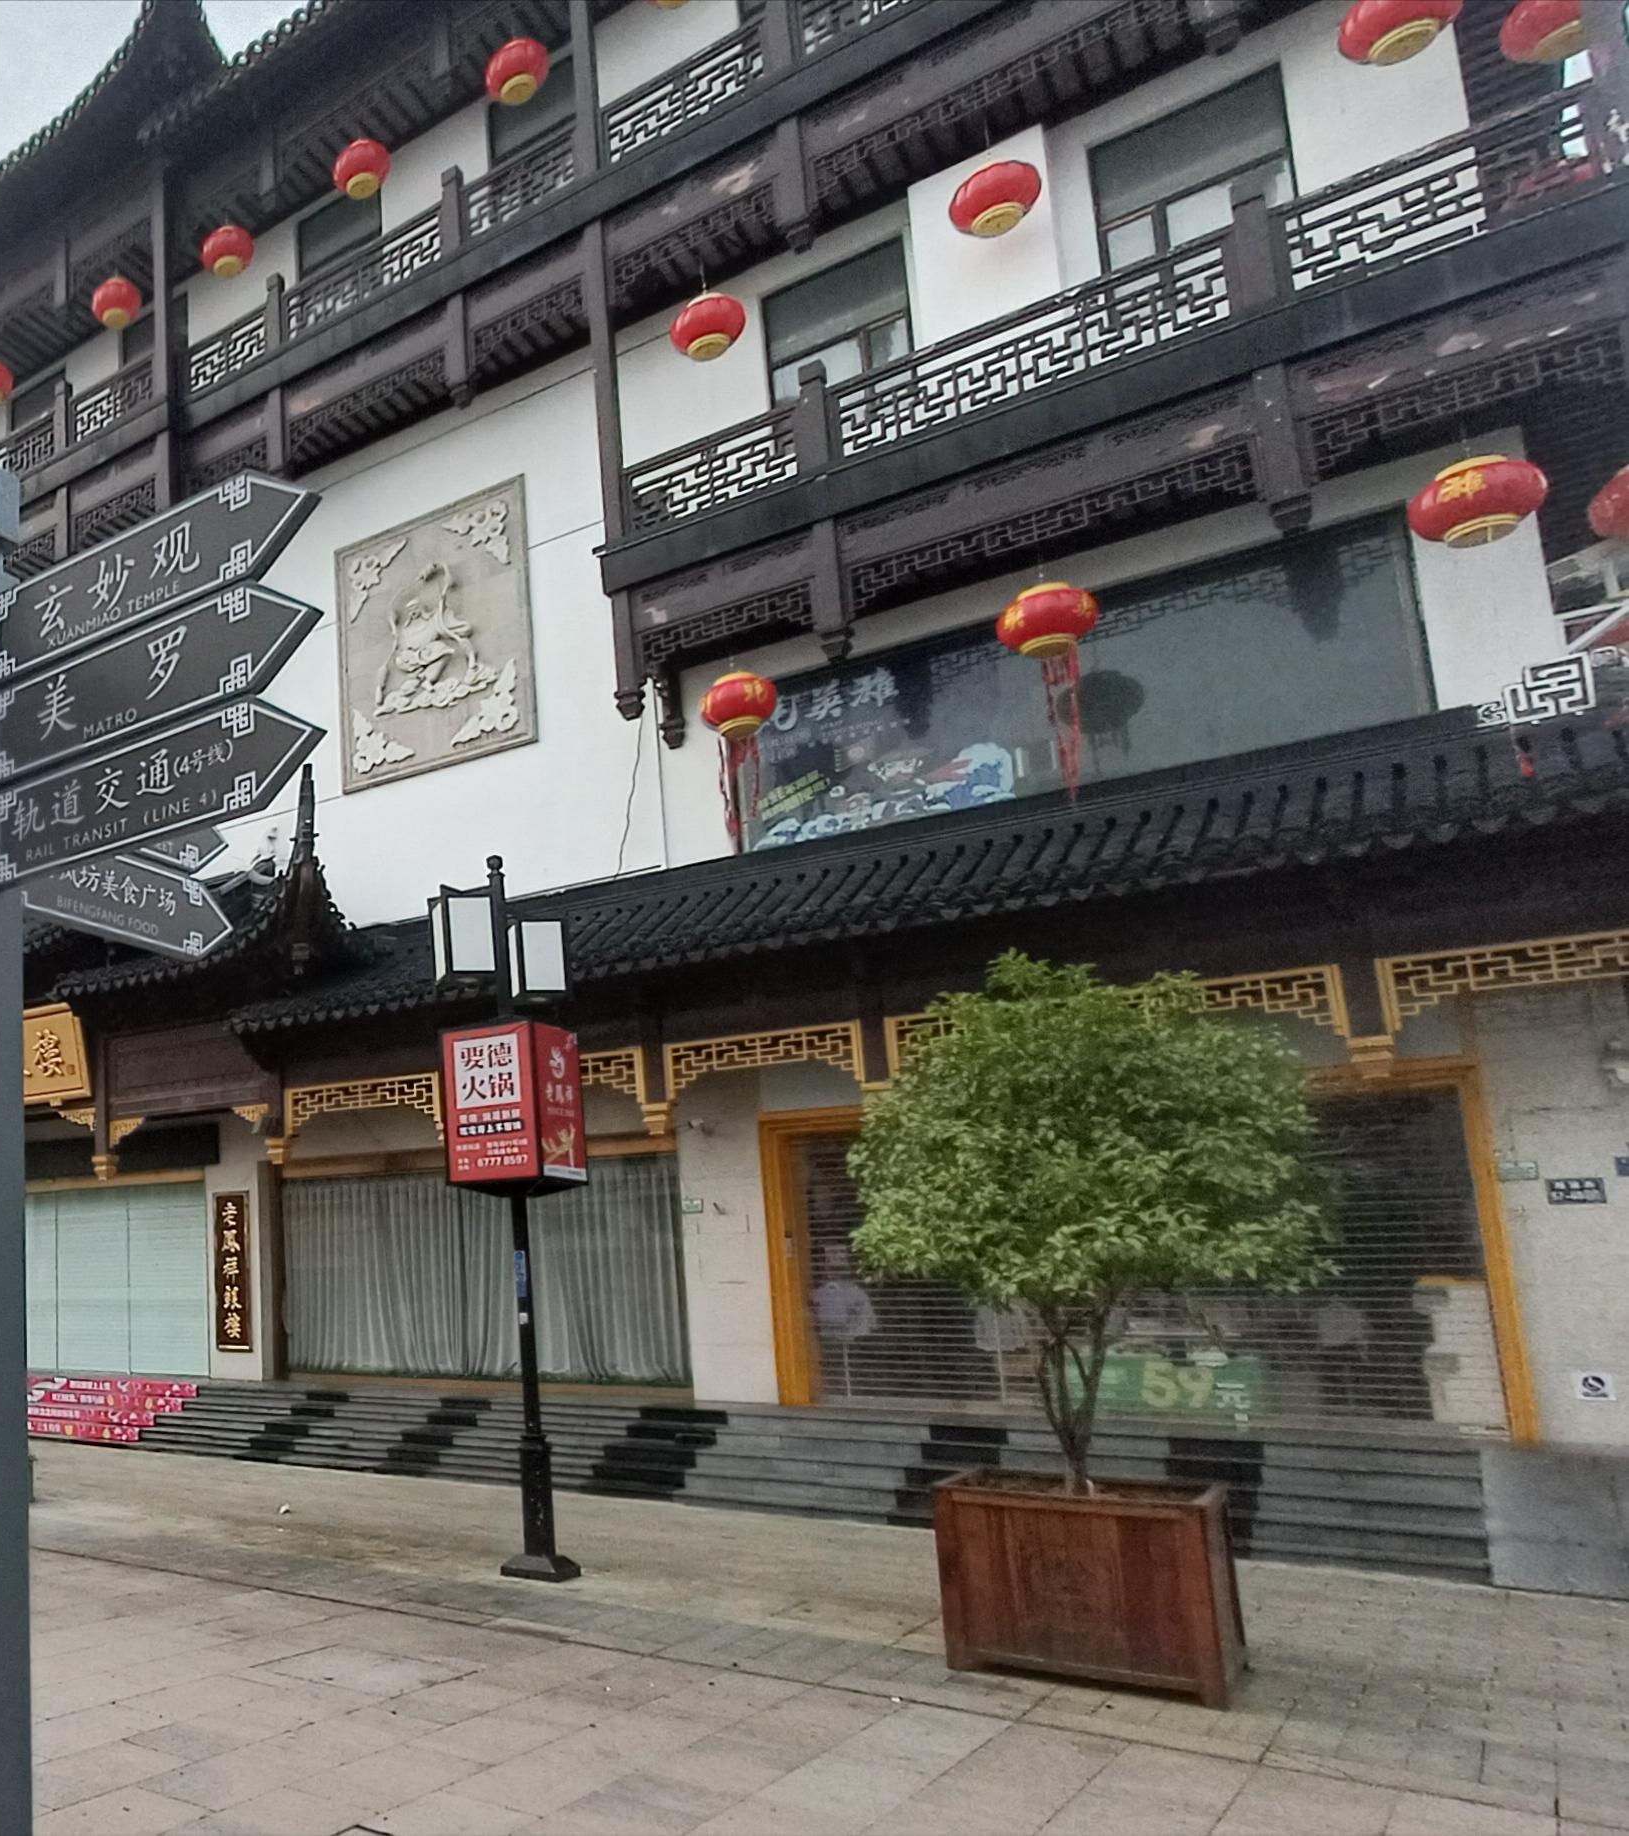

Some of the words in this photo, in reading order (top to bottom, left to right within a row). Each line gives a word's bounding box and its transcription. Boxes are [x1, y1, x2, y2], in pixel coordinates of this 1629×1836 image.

[34, 521, 200, 639] 玄妙观
[46, 609, 122, 649] XUANMIAO
[125, 580, 181, 615] TEMPLE
[83, 708, 137, 740] MATRO
[25, 843, 55, 862] RAIL
[63, 817, 128, 848] TRANSIT
[143, 794, 192, 827] (LINE
[56, 894, 125, 927] BIFENGFANG
[128, 918, 159, 936] FOOD
[461, 1042, 513, 1072] 要德
[461, 1072, 515, 1101] 火锅
